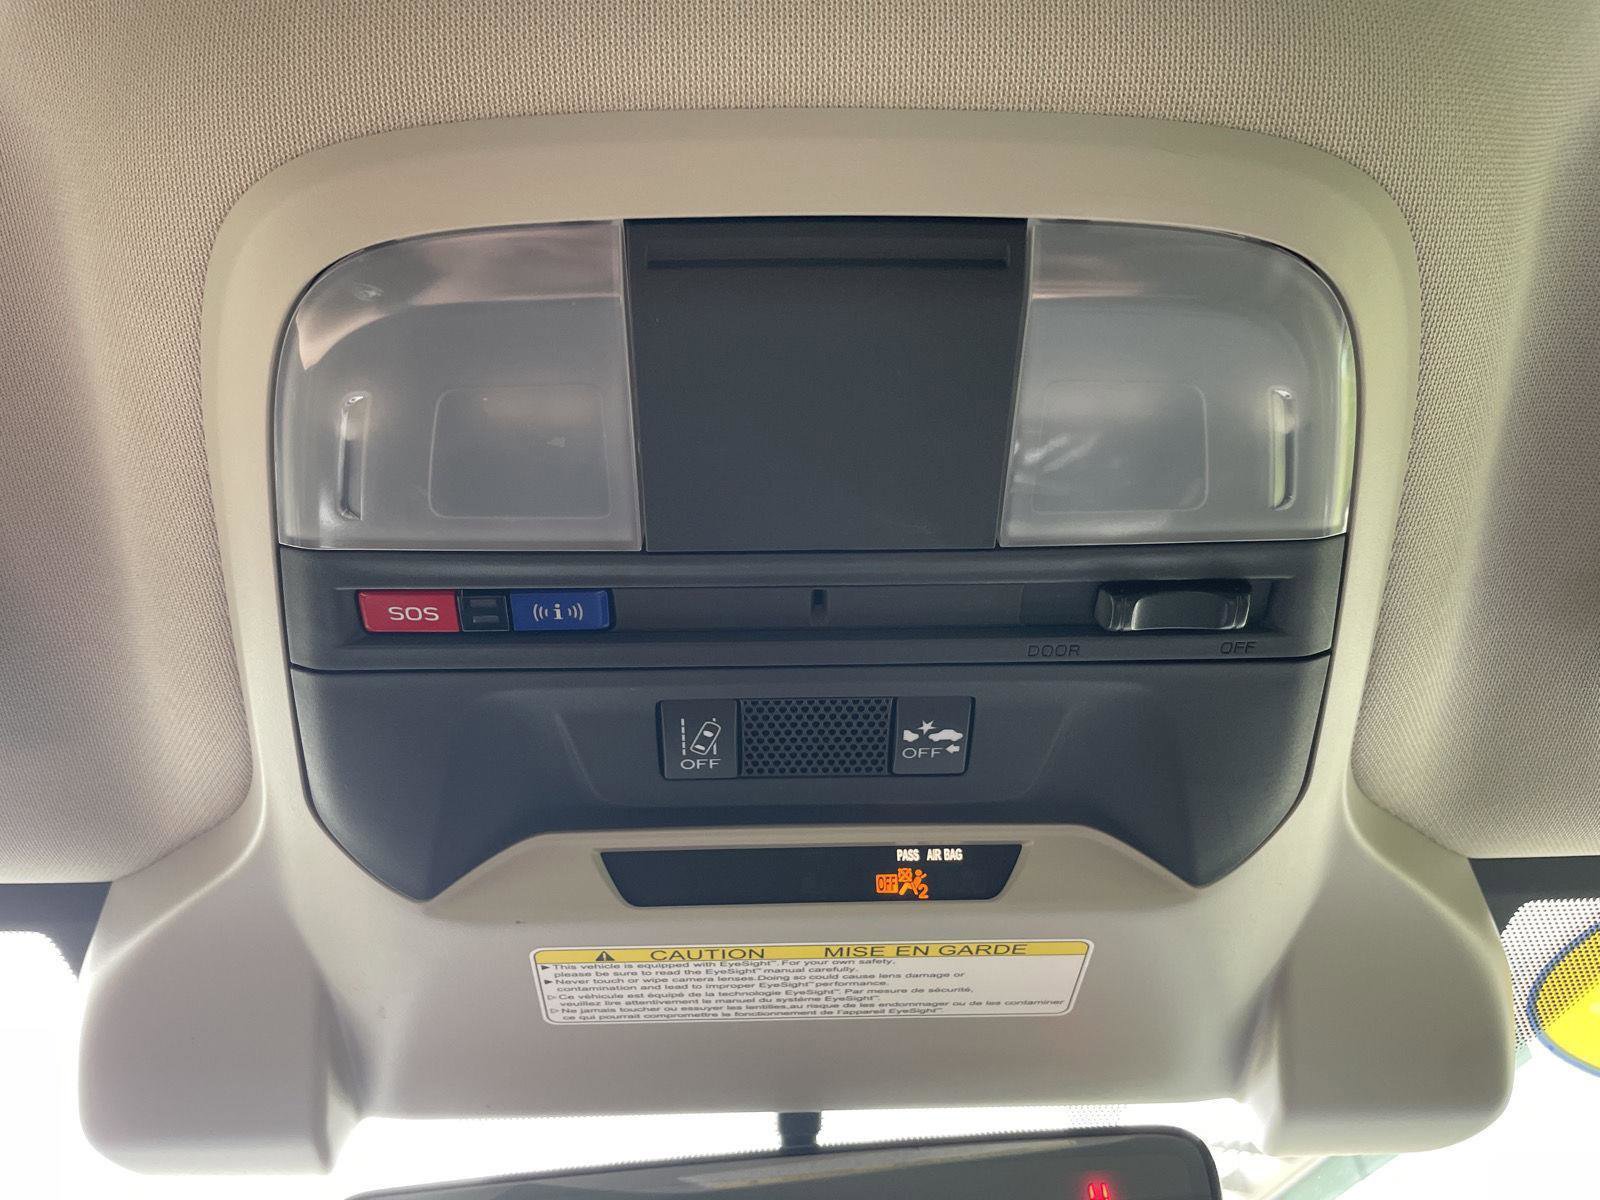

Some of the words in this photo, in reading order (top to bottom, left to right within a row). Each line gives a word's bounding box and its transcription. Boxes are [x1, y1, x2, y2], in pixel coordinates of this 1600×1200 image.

[388, 606, 440, 621] SOS
[1027, 643, 1081, 657] DOOR
[1220, 641, 1257, 655] OFF
[902, 747, 943, 759] OFF
[680, 758, 722, 770] OFF
[896, 848, 920, 862] PASS
[926, 848, 943, 861] AIR
[943, 847, 963, 861] BAG
[877, 876, 897, 892] OFF
[650, 948, 765, 961] CAUTION
[824, 945, 885, 958] MISE
[895, 945, 930, 957] EN
[938, 943, 1028, 956] GARDE
[718, 990, 781, 998] technologie
[878, 1000, 949, 1008] endommager
